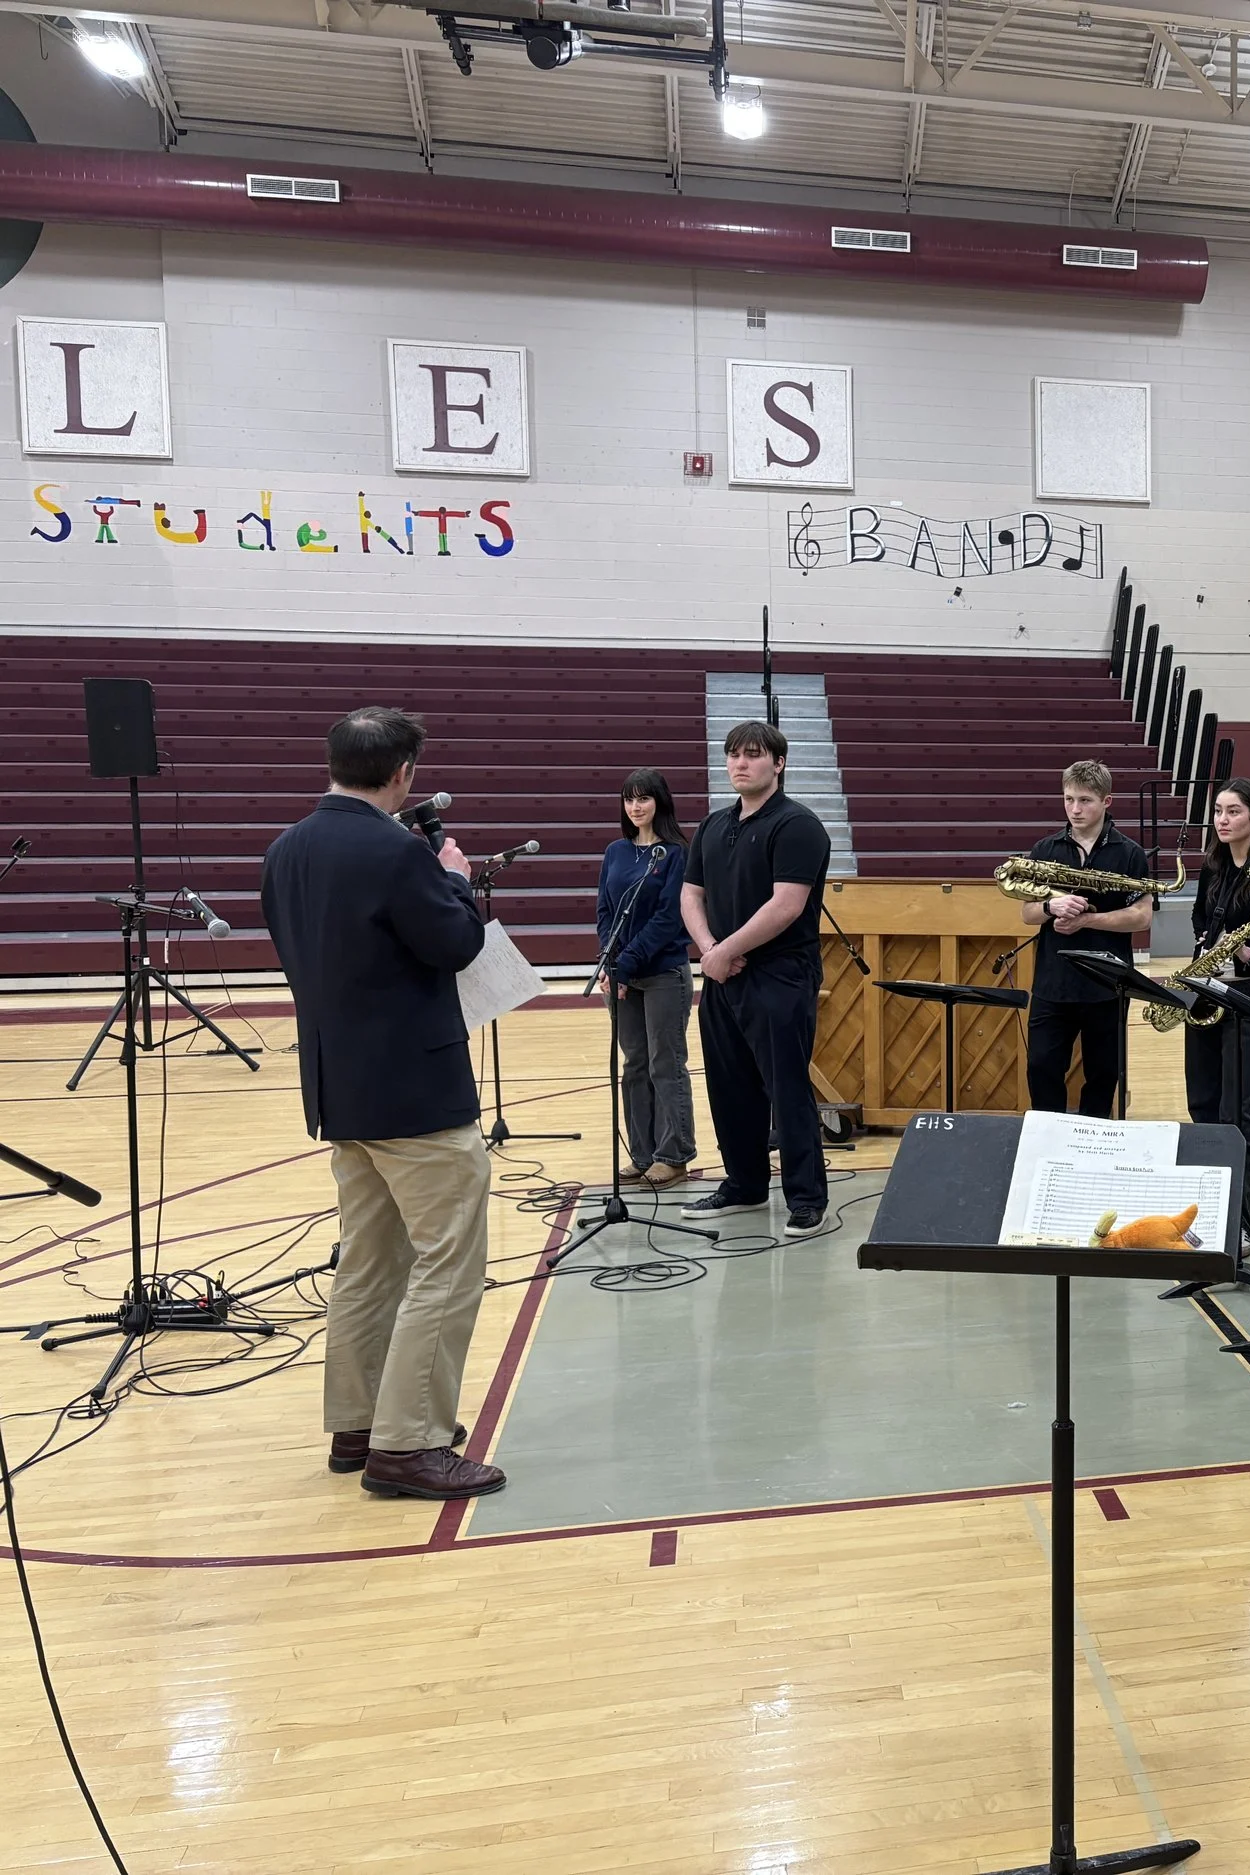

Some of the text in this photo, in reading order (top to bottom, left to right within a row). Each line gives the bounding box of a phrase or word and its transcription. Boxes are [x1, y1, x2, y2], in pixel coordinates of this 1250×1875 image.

[50, 342, 821, 468] L E S
[846, 505, 1052, 577] BAND
[916, 1117, 954, 1130] EHS
